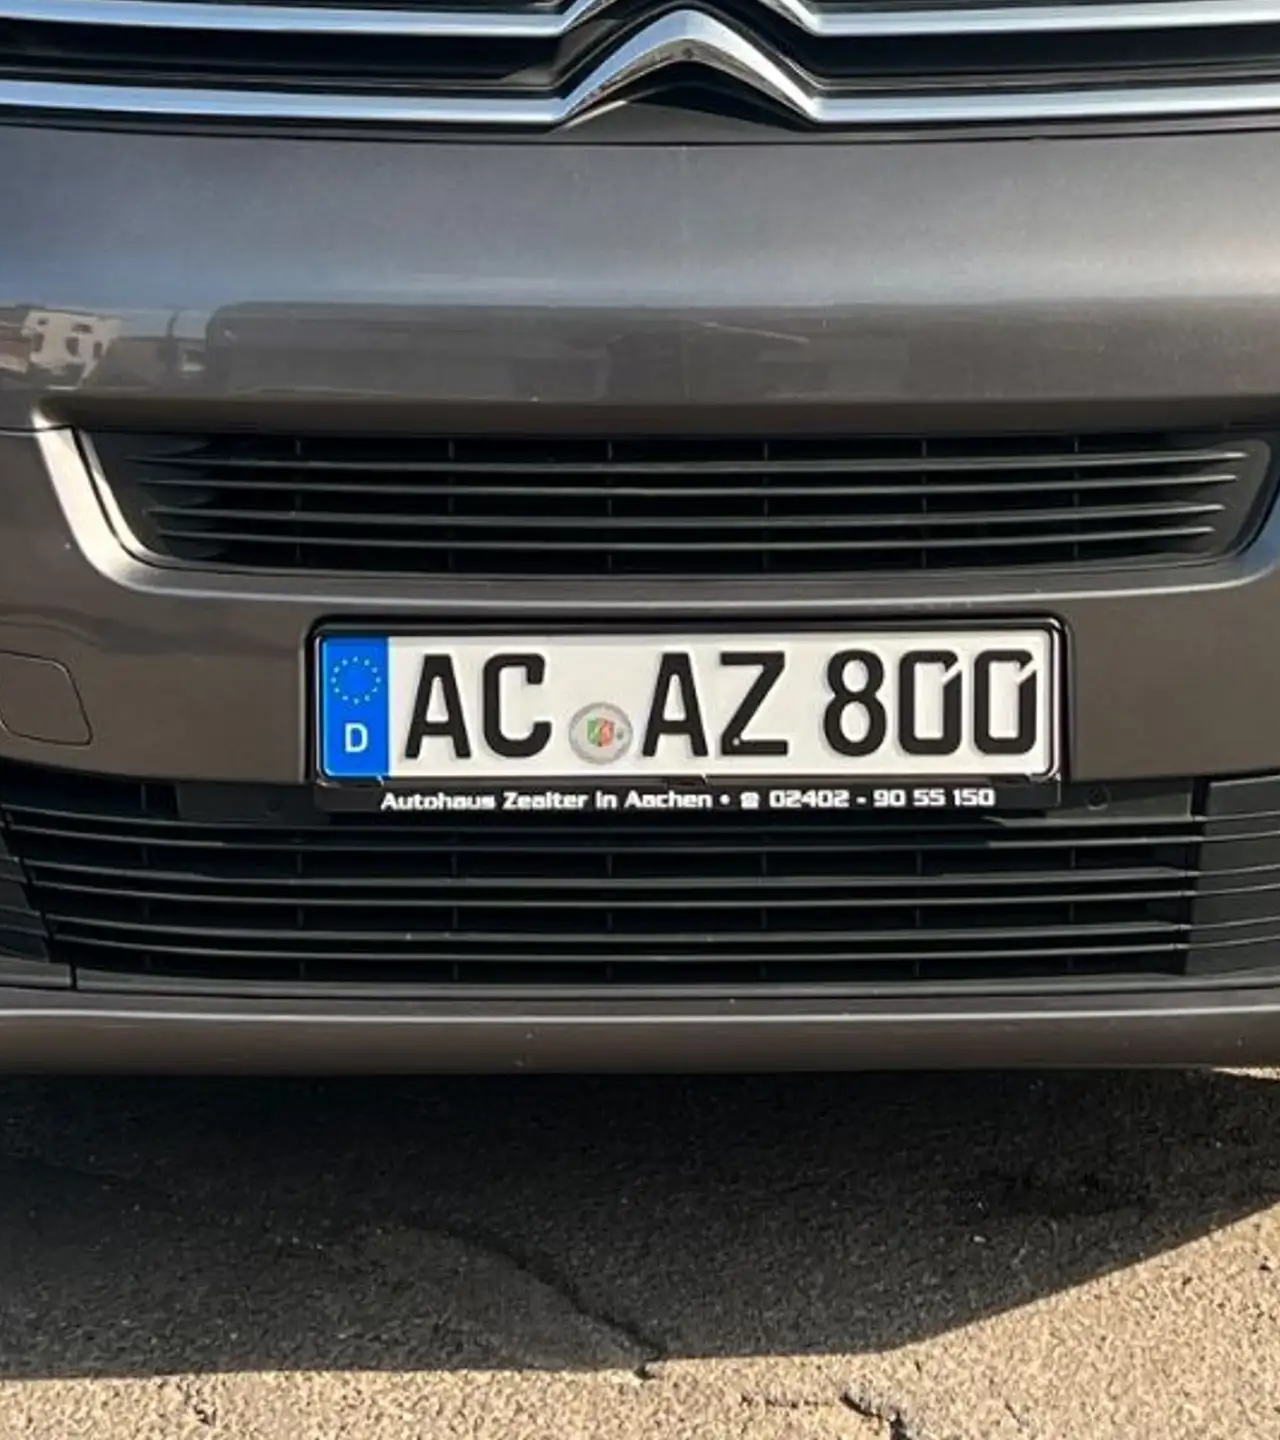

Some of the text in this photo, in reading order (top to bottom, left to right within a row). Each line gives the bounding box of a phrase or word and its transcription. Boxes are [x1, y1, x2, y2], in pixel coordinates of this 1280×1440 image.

[404, 649, 1038, 759] AC AZ 800
[345, 723, 368, 753] D
[380, 791, 496, 810] Autohaus
[624, 789, 713, 809] Aachen
[769, 789, 850, 808] 02402
[873, 789, 906, 808] 90
[913, 788, 946, 807] 55
[953, 788, 996, 807] 150
